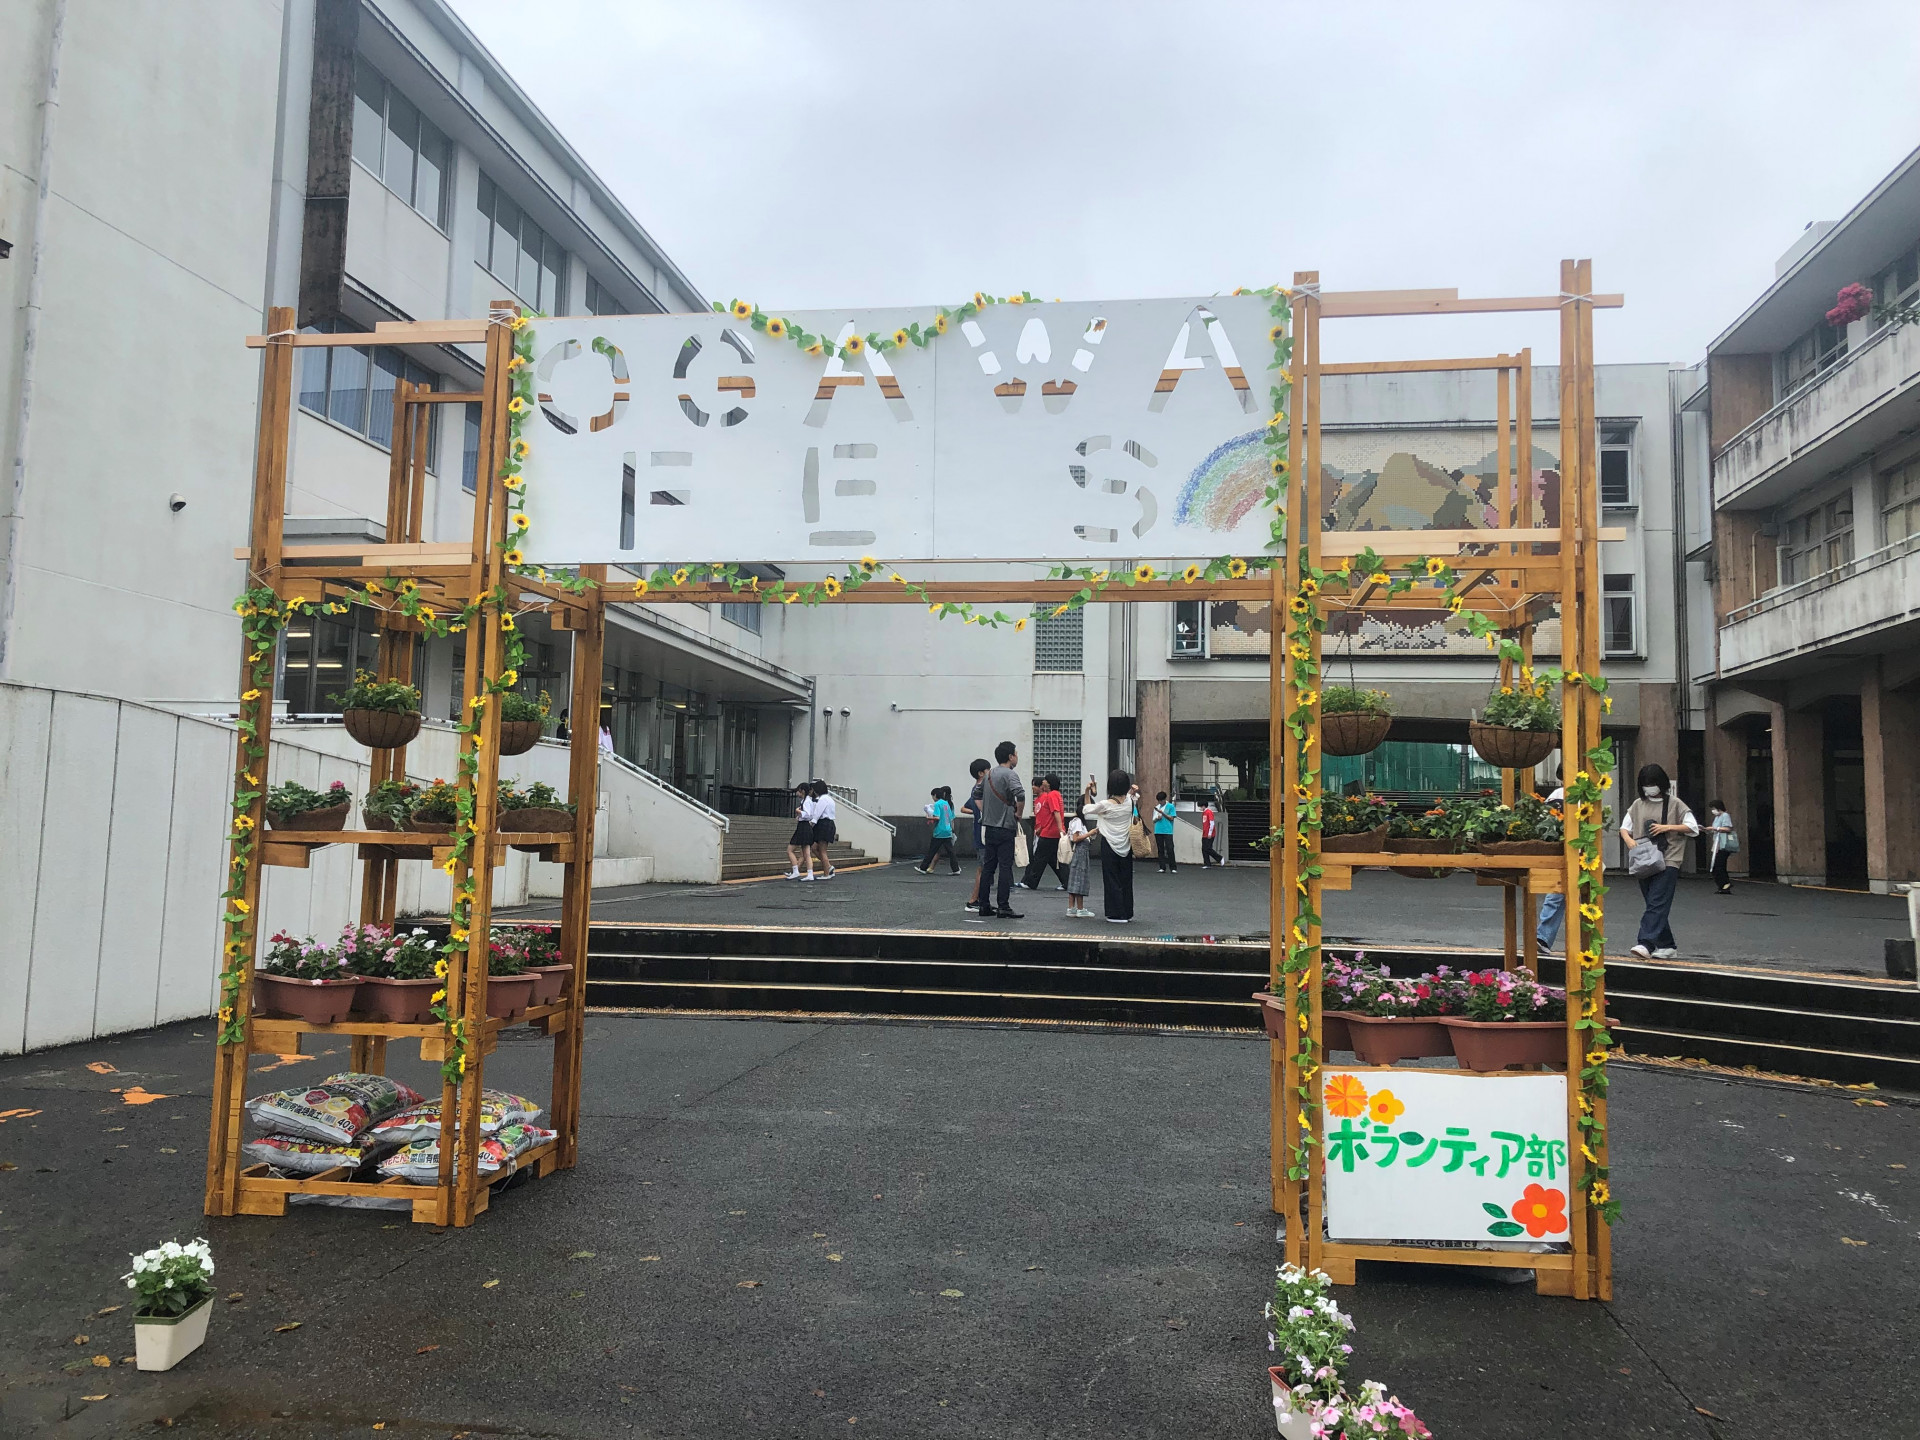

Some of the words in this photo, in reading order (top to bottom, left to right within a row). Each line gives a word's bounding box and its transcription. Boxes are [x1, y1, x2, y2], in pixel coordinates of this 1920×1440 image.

[537, 305, 1259, 435] OGAWA
[620, 435, 1159, 551] FES
[1328, 1117, 1567, 1181] ボランティア部
